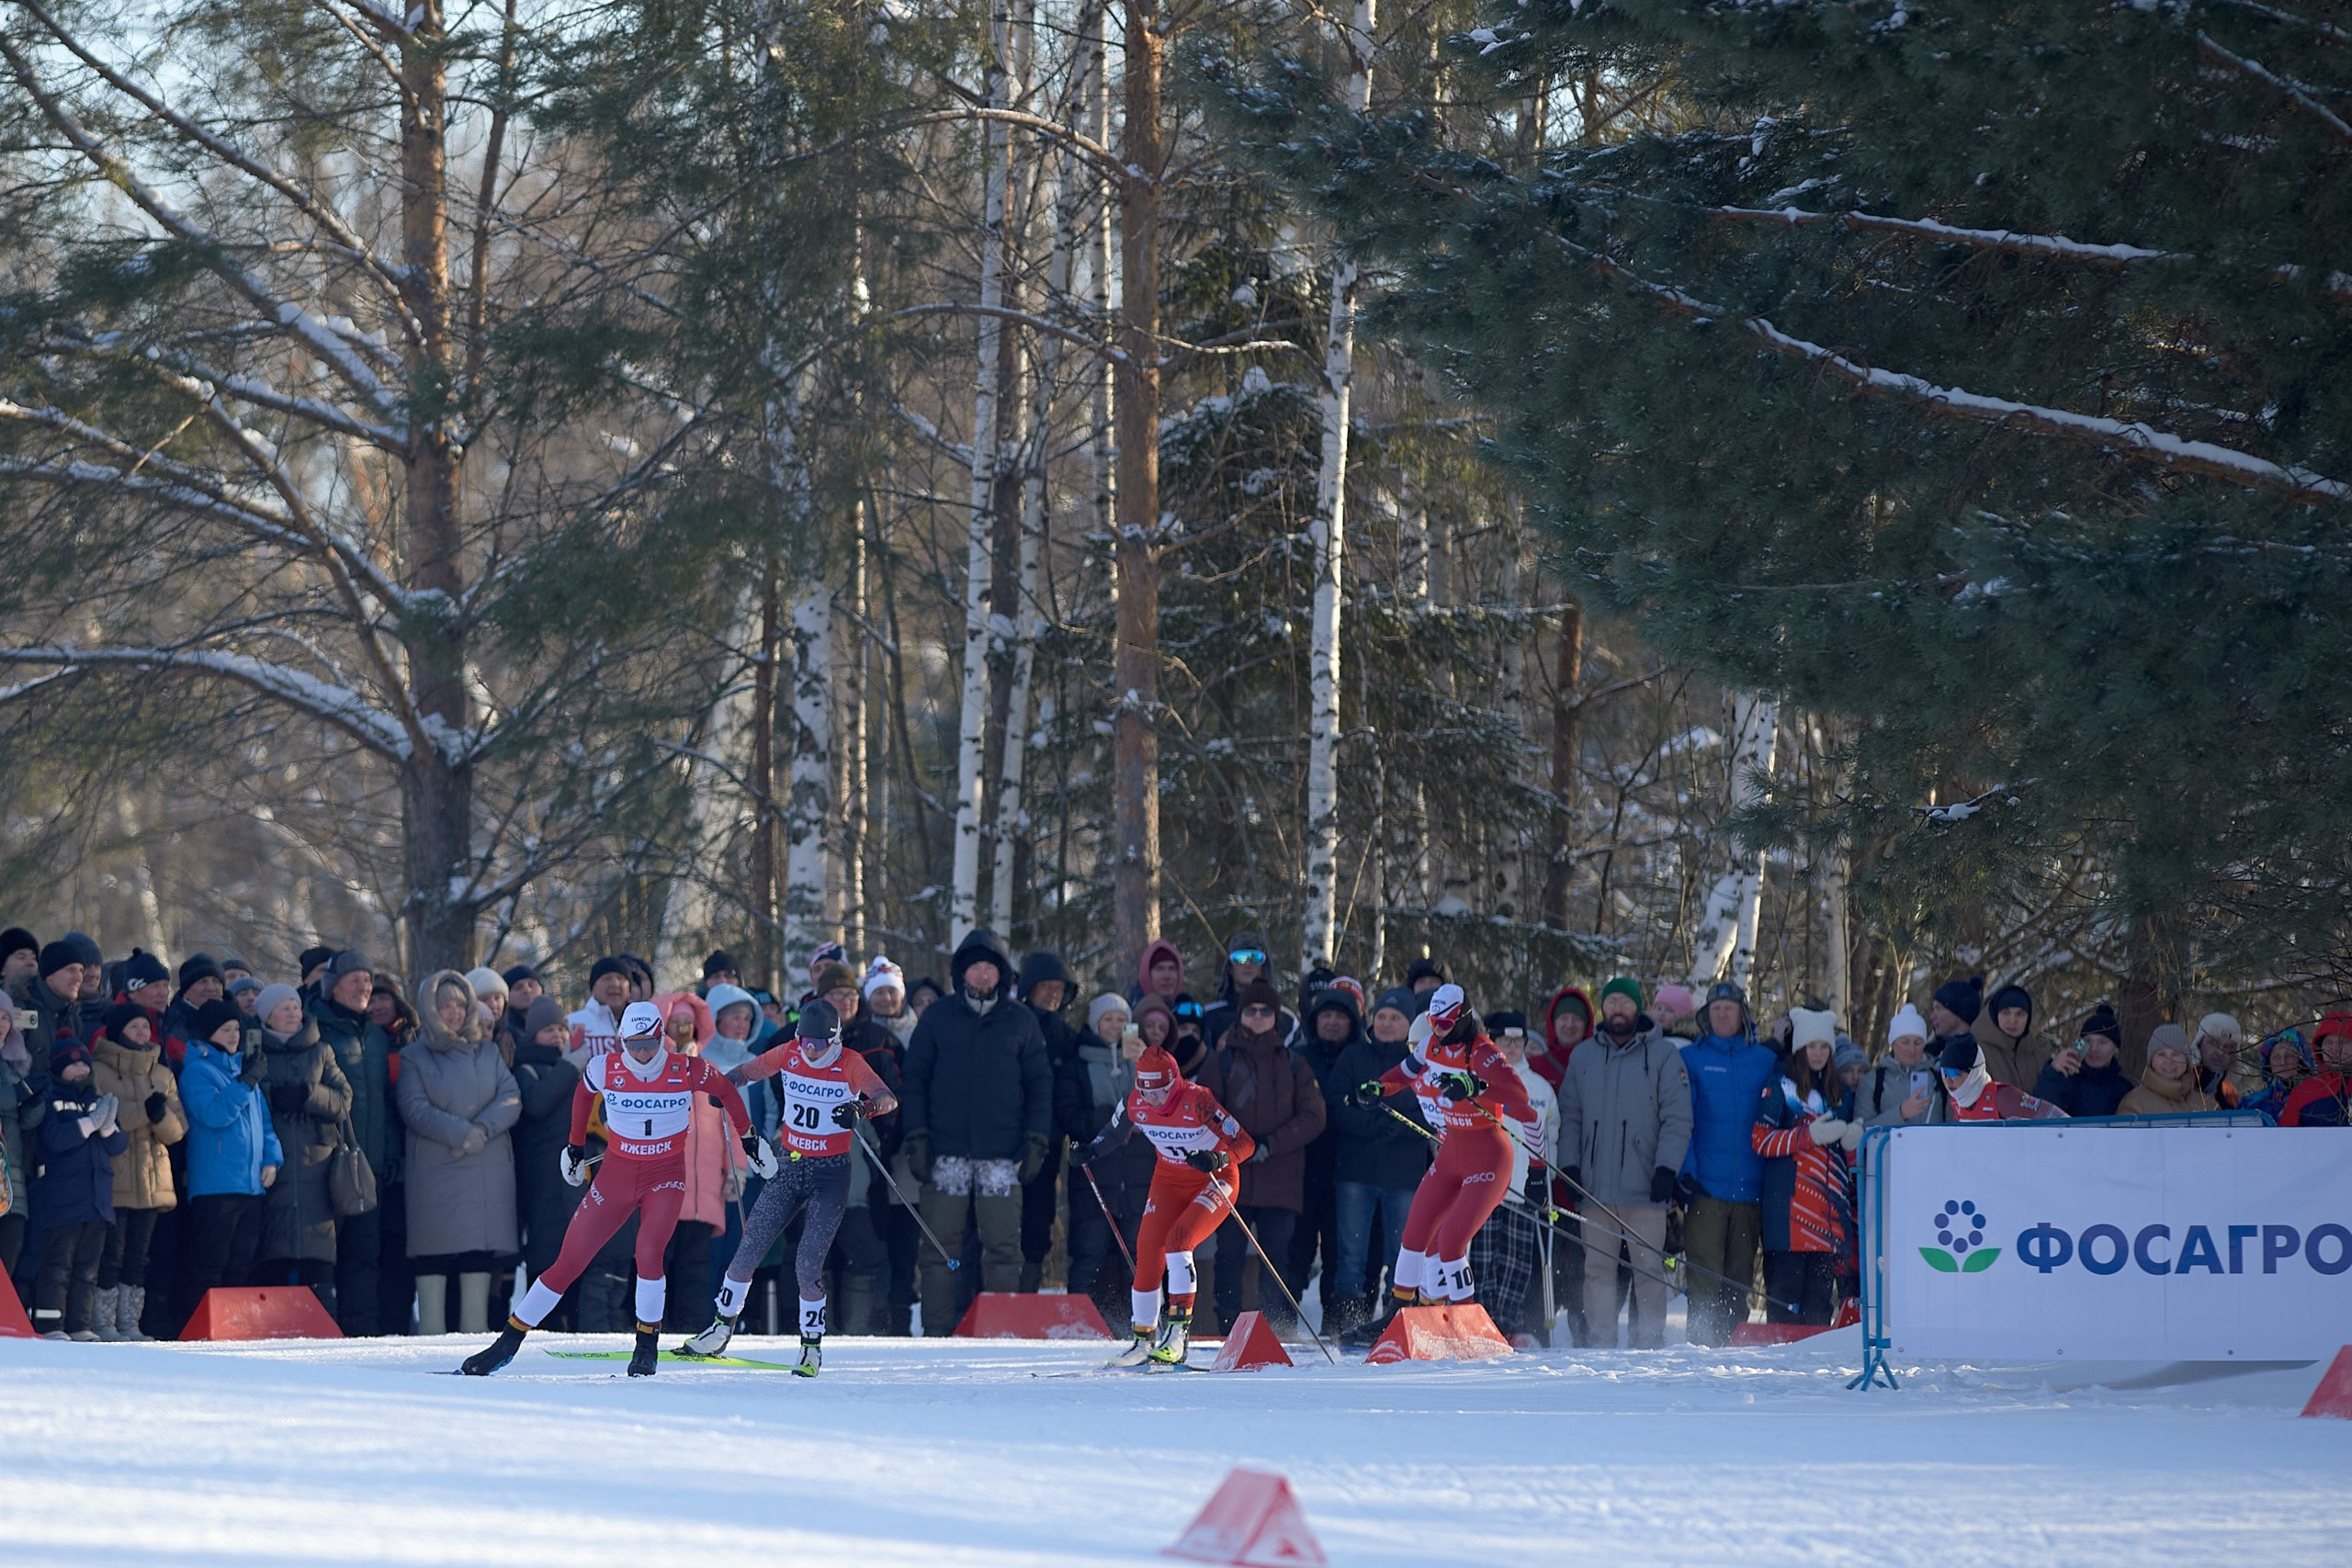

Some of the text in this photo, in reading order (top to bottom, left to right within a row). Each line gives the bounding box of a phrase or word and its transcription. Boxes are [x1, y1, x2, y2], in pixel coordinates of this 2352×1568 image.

[789, 1080, 844, 1098] ФОСАГРО
[621, 1098, 687, 1109] ФОСАГРО
[793, 1103, 820, 1129] 20
[641, 1119, 652, 1136] 1
[1148, 1128, 1204, 1140] ФОСАГРО
[620, 1140, 672, 1155] ИЖЕВСК
[2017, 1223, 2352, 1276] ФОСАГРО
[1451, 1267, 1473, 1290] 10
